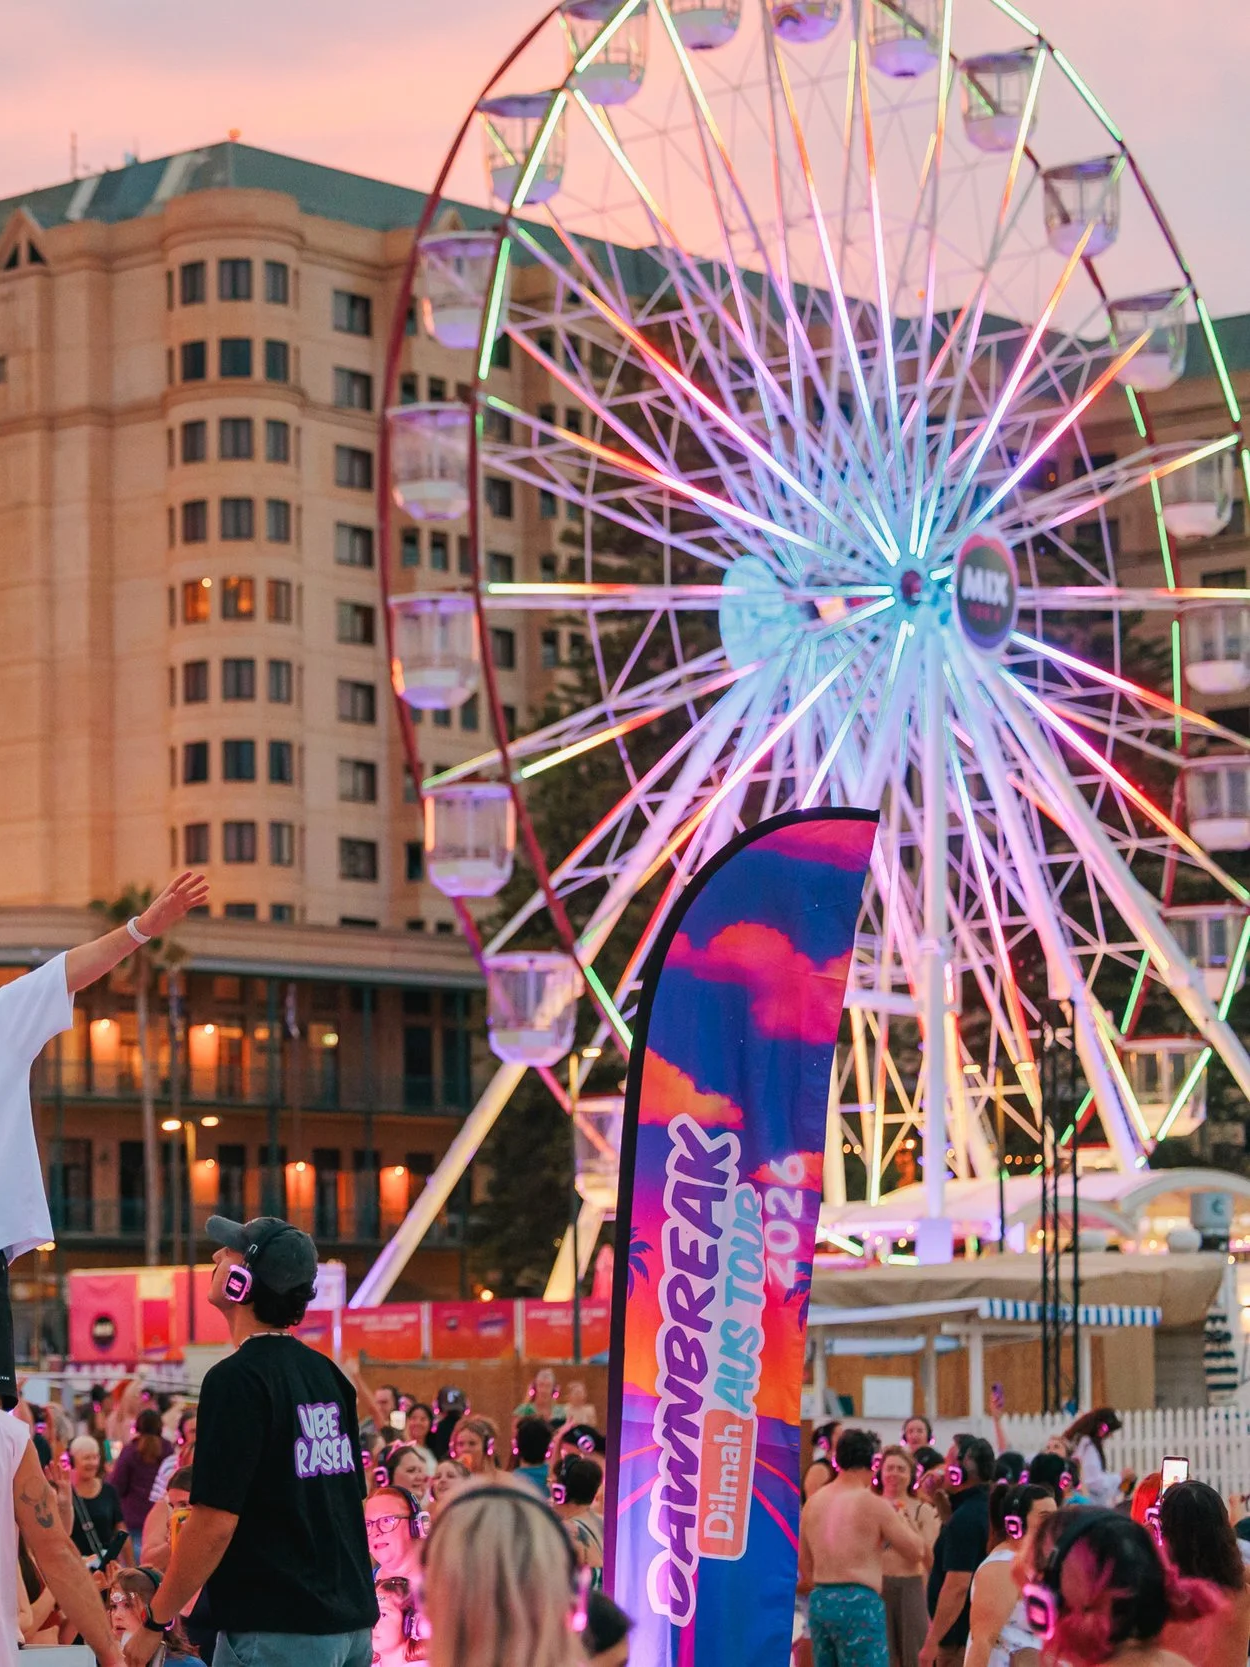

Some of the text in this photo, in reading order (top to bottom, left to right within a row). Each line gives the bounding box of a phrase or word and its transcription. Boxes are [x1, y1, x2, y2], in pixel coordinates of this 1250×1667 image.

[962, 565, 1008, 607] MIX
[764, 1153, 806, 1290] 2026
[713, 1187, 764, 1415] AUS TOUR
[654, 1121, 733, 1619] DAWNBREAK
[703, 1423, 744, 1542] Dilmah
